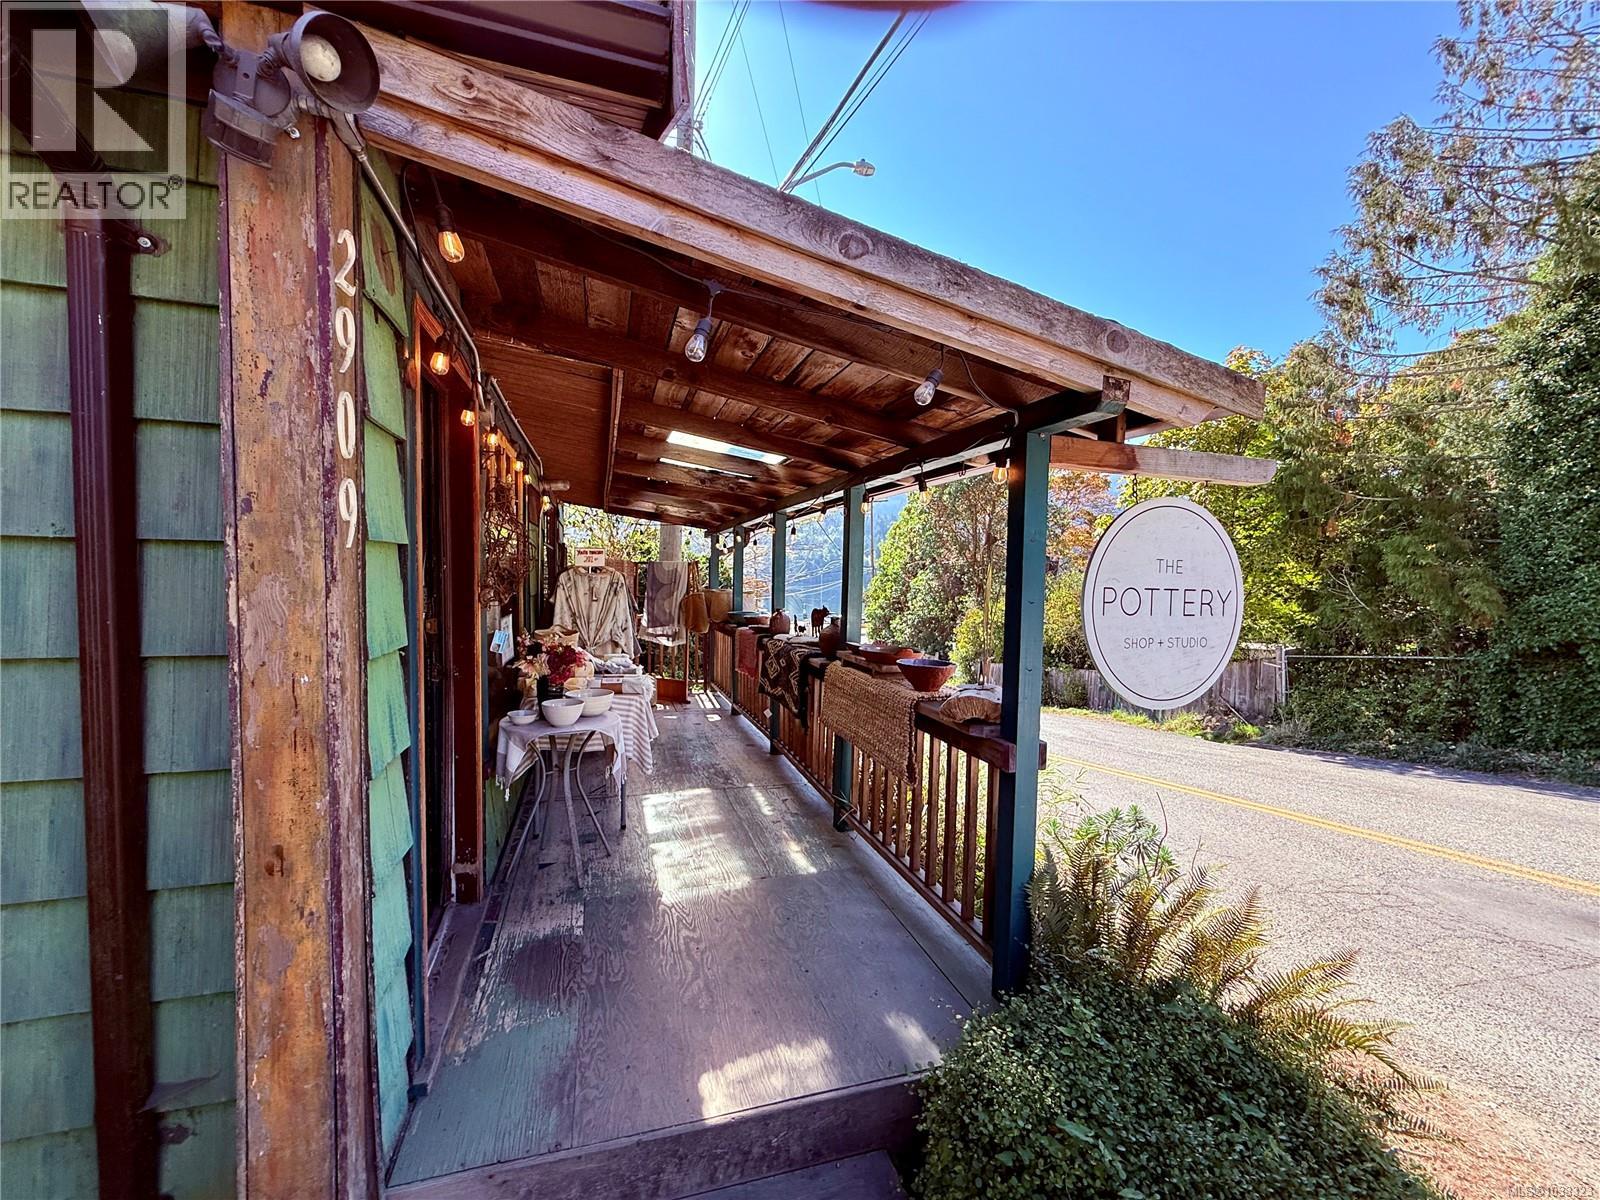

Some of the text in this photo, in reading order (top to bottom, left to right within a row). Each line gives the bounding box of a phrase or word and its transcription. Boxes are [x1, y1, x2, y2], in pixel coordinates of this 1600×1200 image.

[334, 228, 358, 549] 2909
[1156, 558, 1184, 574] THE
[1102, 586, 1232, 617] POTTERY
[1123, 637, 1154, 650] SHOP
[1166, 636, 1208, 649] STUDIO
